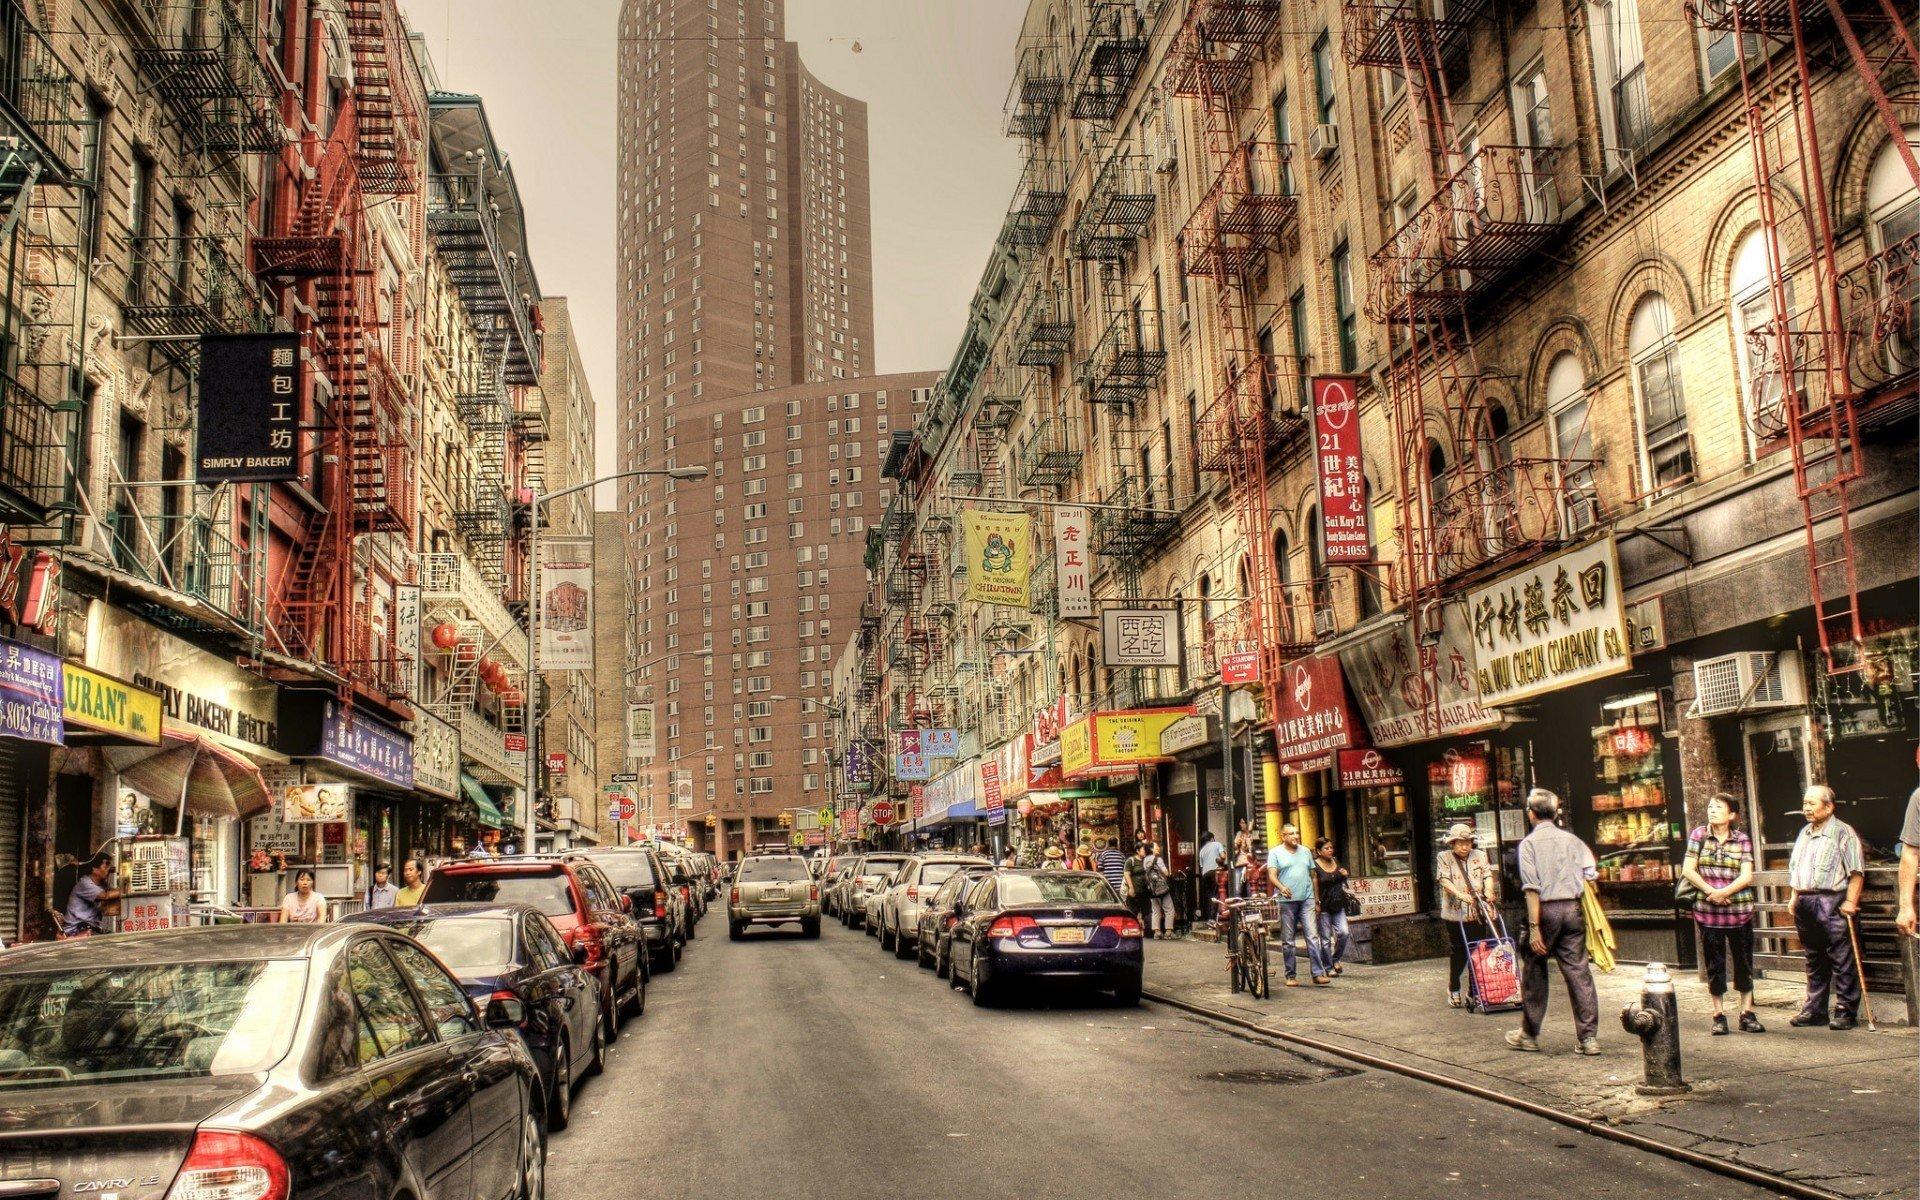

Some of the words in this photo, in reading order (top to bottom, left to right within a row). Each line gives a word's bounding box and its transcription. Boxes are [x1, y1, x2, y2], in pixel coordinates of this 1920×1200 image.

[271, 348, 293, 449] 麵包工坊
[1320, 433, 1342, 450] 21
[203, 457, 245, 468] SIMPLY
[246, 457, 292, 467] BAKERY
[1323, 455, 1345, 498] 世紀
[1346, 455, 1362, 512] 美容中心
[1355, 515, 1365, 527] 21
[1062, 525, 1083, 591] 老正川
[1327, 545, 1367, 556] 693-1055
[975, 583, 1023, 595] CHINATOWN
[1120, 617, 1162, 637] 西安
[1122, 637, 1162, 654] 名吃
[1547, 627, 1602, 677] COMPANY
[1228, 663, 1252, 672] ANYTIME
[1232, 655, 1257, 664] STANDING
[64, 673, 127, 727] URANT
[187, 692, 234, 736] BAKERY
[1374, 719, 1413, 743] BAYARD
[873, 809, 893, 819] STOP
[1368, 893, 1411, 904] RESTAURANT
[73, 1177, 135, 1193] CAMRY
[140, 1175, 160, 1187] LE
